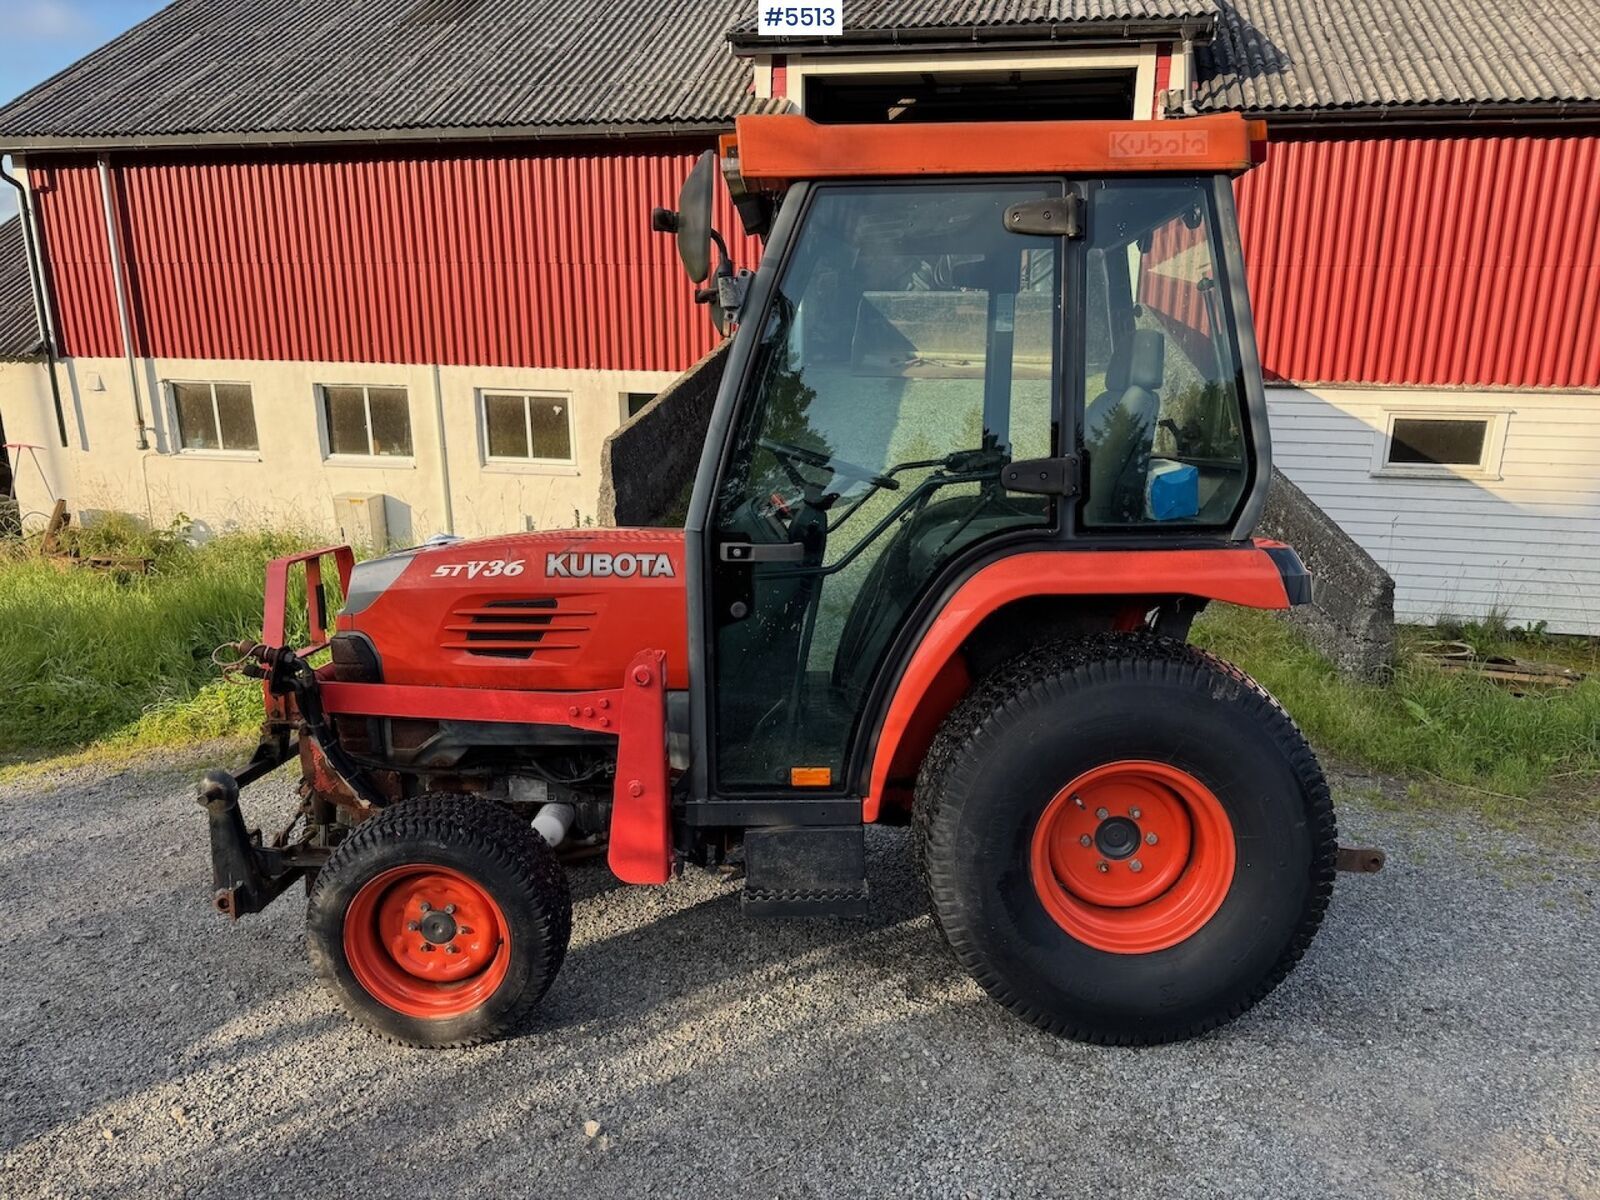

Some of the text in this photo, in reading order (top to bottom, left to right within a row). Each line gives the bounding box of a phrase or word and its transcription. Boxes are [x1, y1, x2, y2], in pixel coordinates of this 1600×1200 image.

[1110, 133, 1206, 155] Kubota
[431, 559, 526, 579] STV36
[545, 552, 675, 578] KUBOTA
